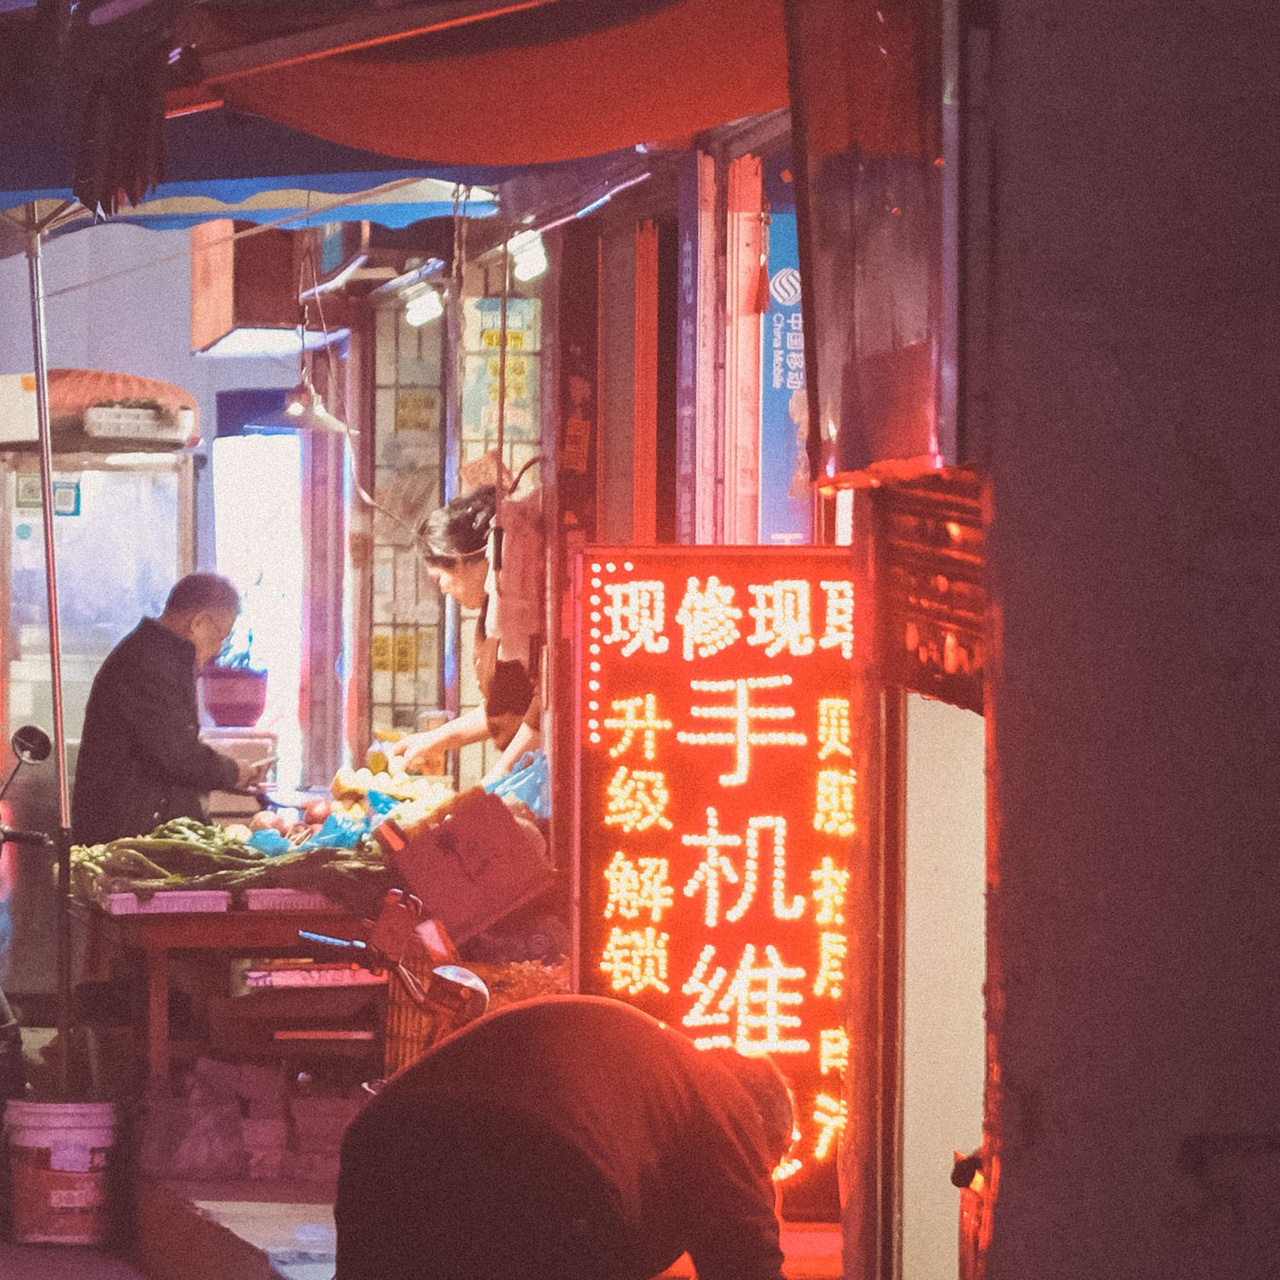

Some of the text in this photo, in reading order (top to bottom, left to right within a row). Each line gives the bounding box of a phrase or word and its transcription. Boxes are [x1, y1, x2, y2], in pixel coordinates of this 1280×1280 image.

[773, 313, 785, 389] China Mobile
[786, 312, 805, 389] 中国移动
[677, 675, 808, 1181] 手机维
